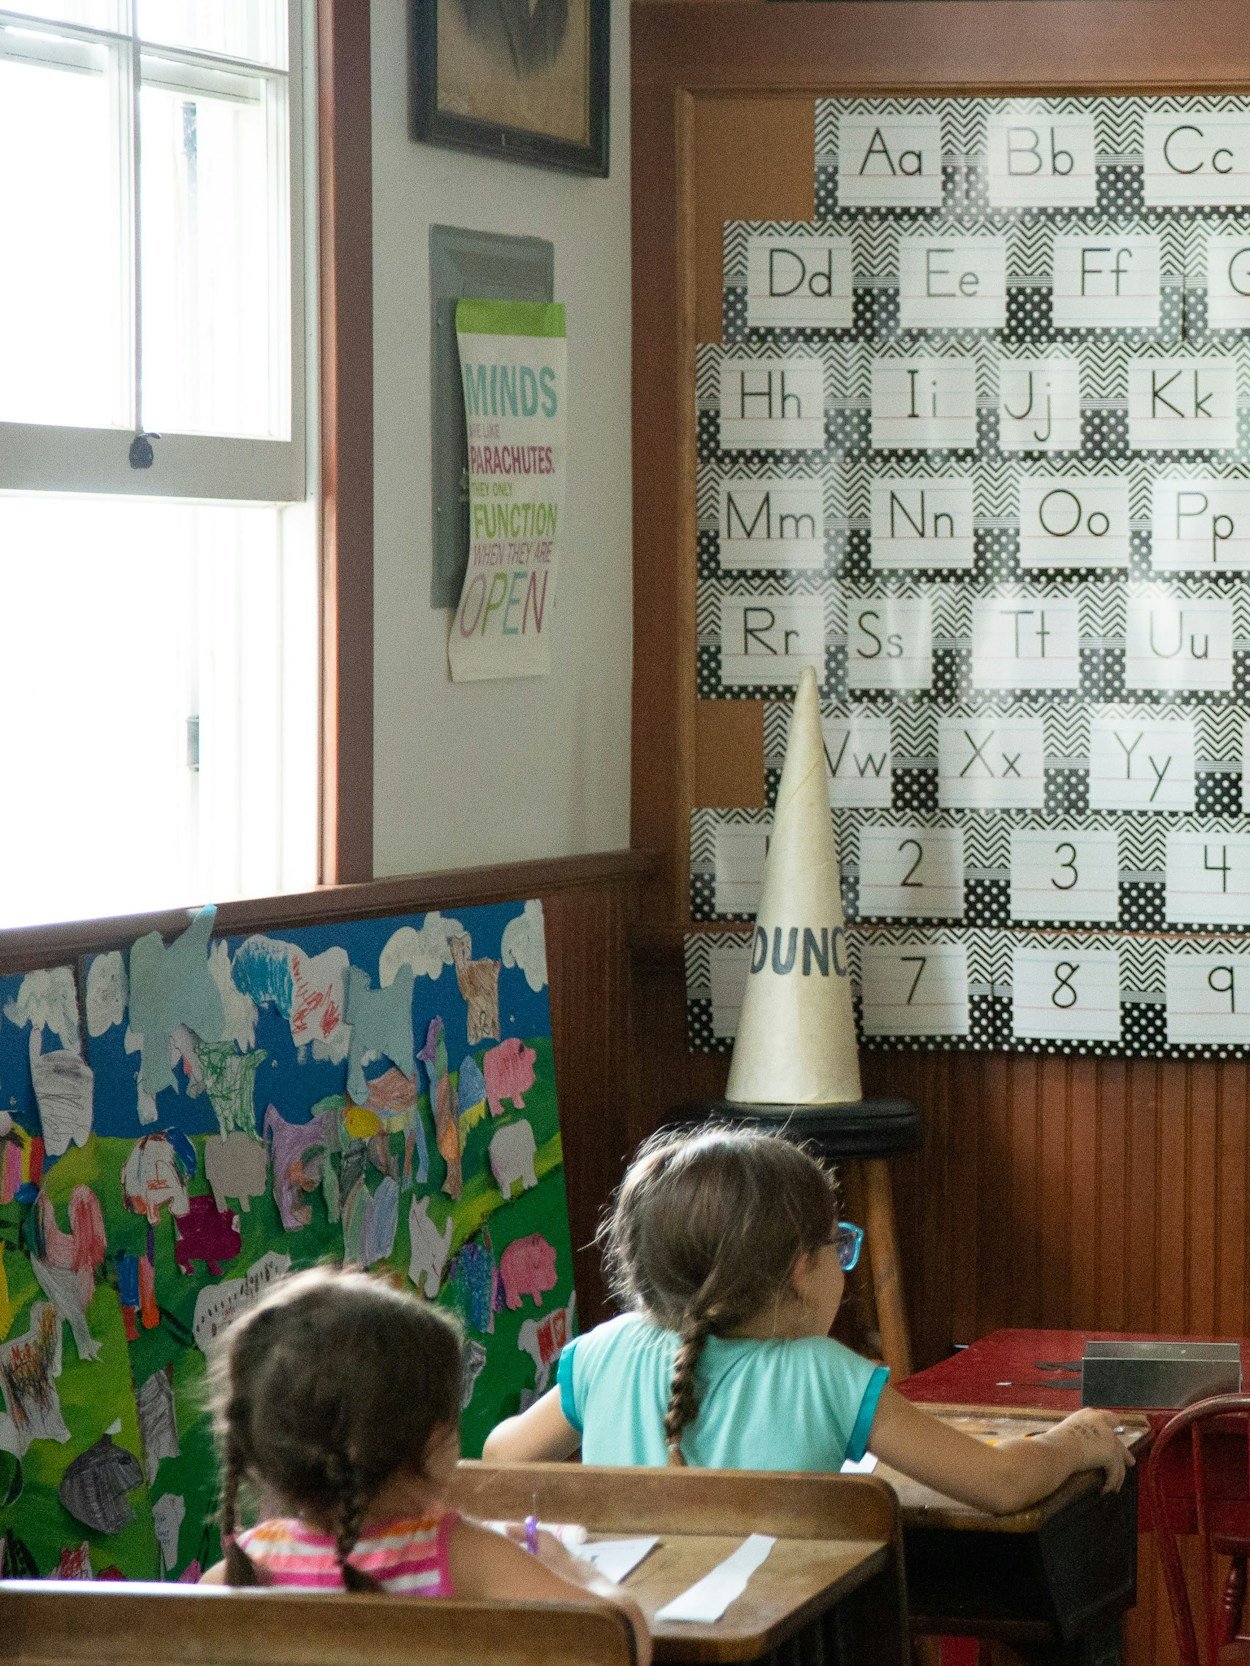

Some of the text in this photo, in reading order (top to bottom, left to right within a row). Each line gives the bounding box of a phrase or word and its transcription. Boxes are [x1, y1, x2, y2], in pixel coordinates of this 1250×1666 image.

[859, 125, 1234, 178] Aa Bb Cc
[769, 248, 834, 298] Dd
[925, 248, 980, 298] Ee
[1079, 247, 1132, 296] Ff
[464, 363, 558, 418] MINDS
[739, 370, 802, 420] Hh
[908, 369, 938, 419] Ii
[1004, 372, 1054, 442] Jj
[1150, 369, 1215, 419] Kk
[469, 445, 555, 475] PARACHUTES.
[472, 504, 557, 539] FUNCTION
[725, 490, 816, 541] Mm
[889, 489, 955, 540] Nn
[1038, 489, 1111, 538] Oo
[1175, 490, 1234, 562] Pp
[459, 570, 549, 638] OPEN
[742, 608, 798, 656] Rr
[856, 611, 904, 660] Ss
[1001, 610, 1051, 659] Tt
[1149, 610, 1209, 660] Uu
[959, 730, 1022, 779] Xx
[1112, 731, 1172, 804] Yy
[899, 839, 924, 888] 2
[1051, 844, 1079, 891] 3
[1202, 845, 1232, 892] 4
[900, 956, 926, 1005] 7
[1052, 961, 1080, 1009] 8
[1208, 966, 1235, 1014] 9
